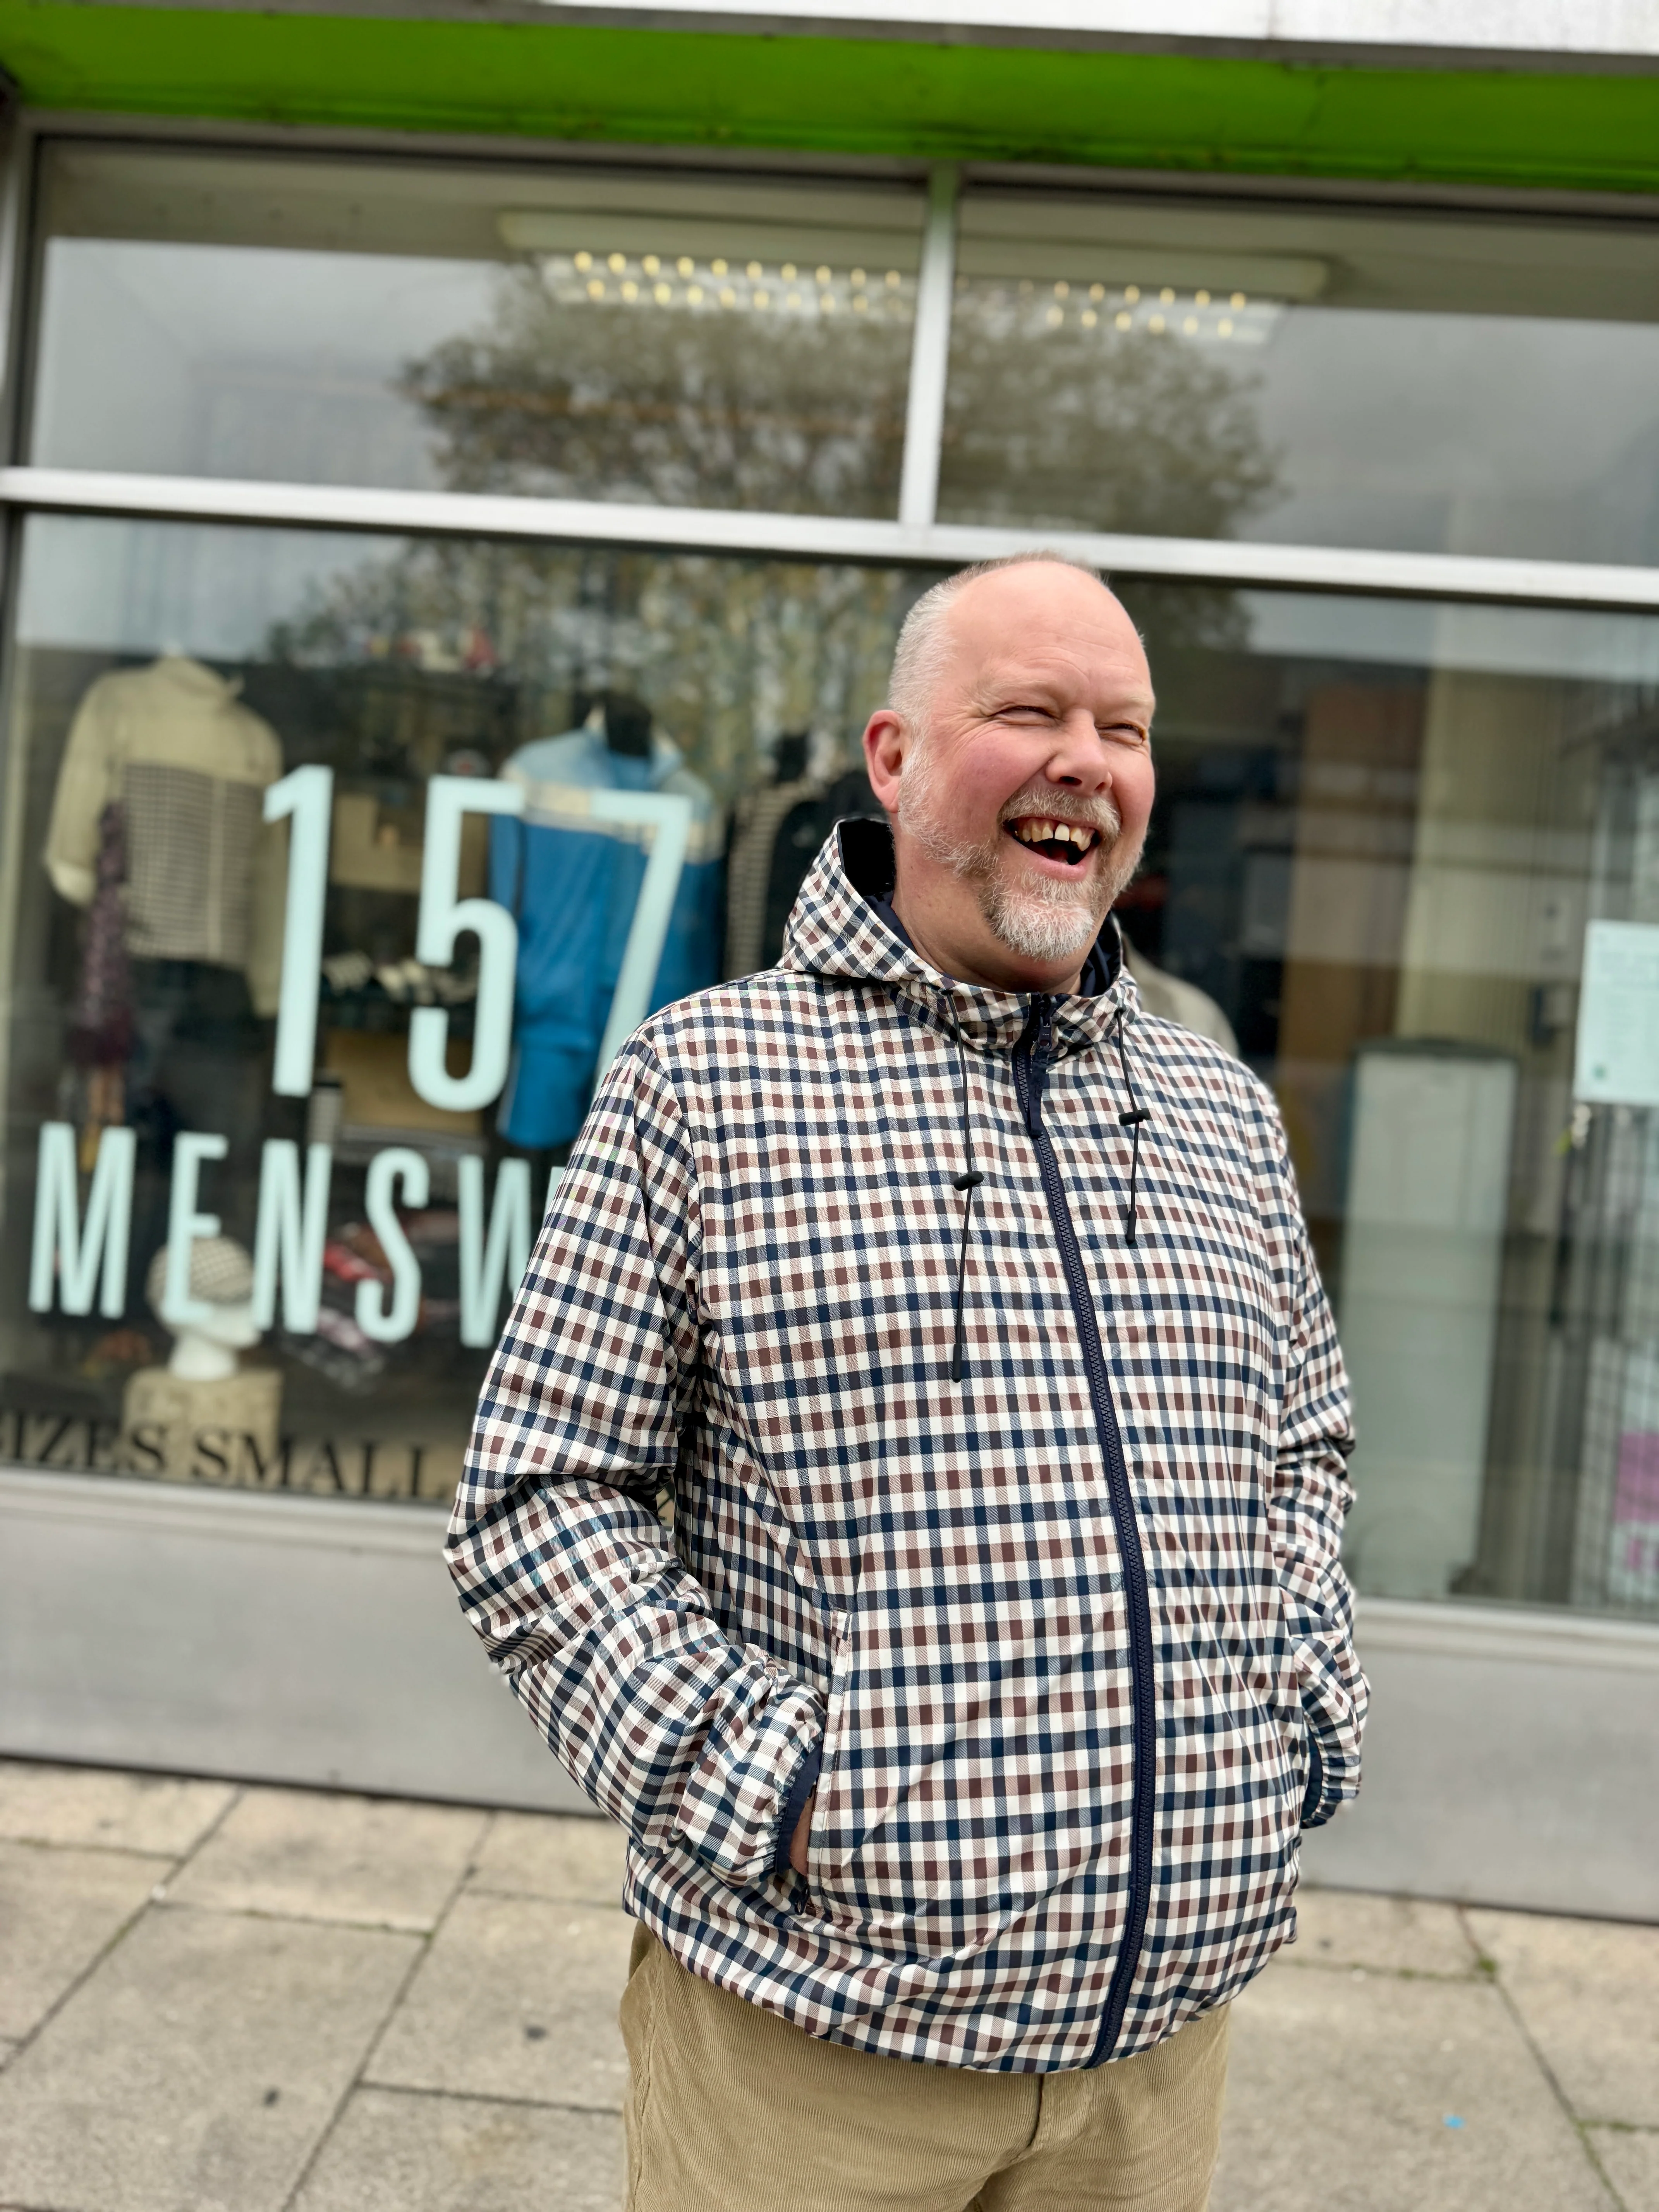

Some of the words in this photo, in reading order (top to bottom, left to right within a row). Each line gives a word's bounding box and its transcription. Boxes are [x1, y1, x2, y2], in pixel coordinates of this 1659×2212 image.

[263, 764, 692, 1112] 157
[29, 1121, 568, 1348] MENSW
[0, 1408, 167, 1474] IZES
[191, 1428, 453, 1500] SMALL
